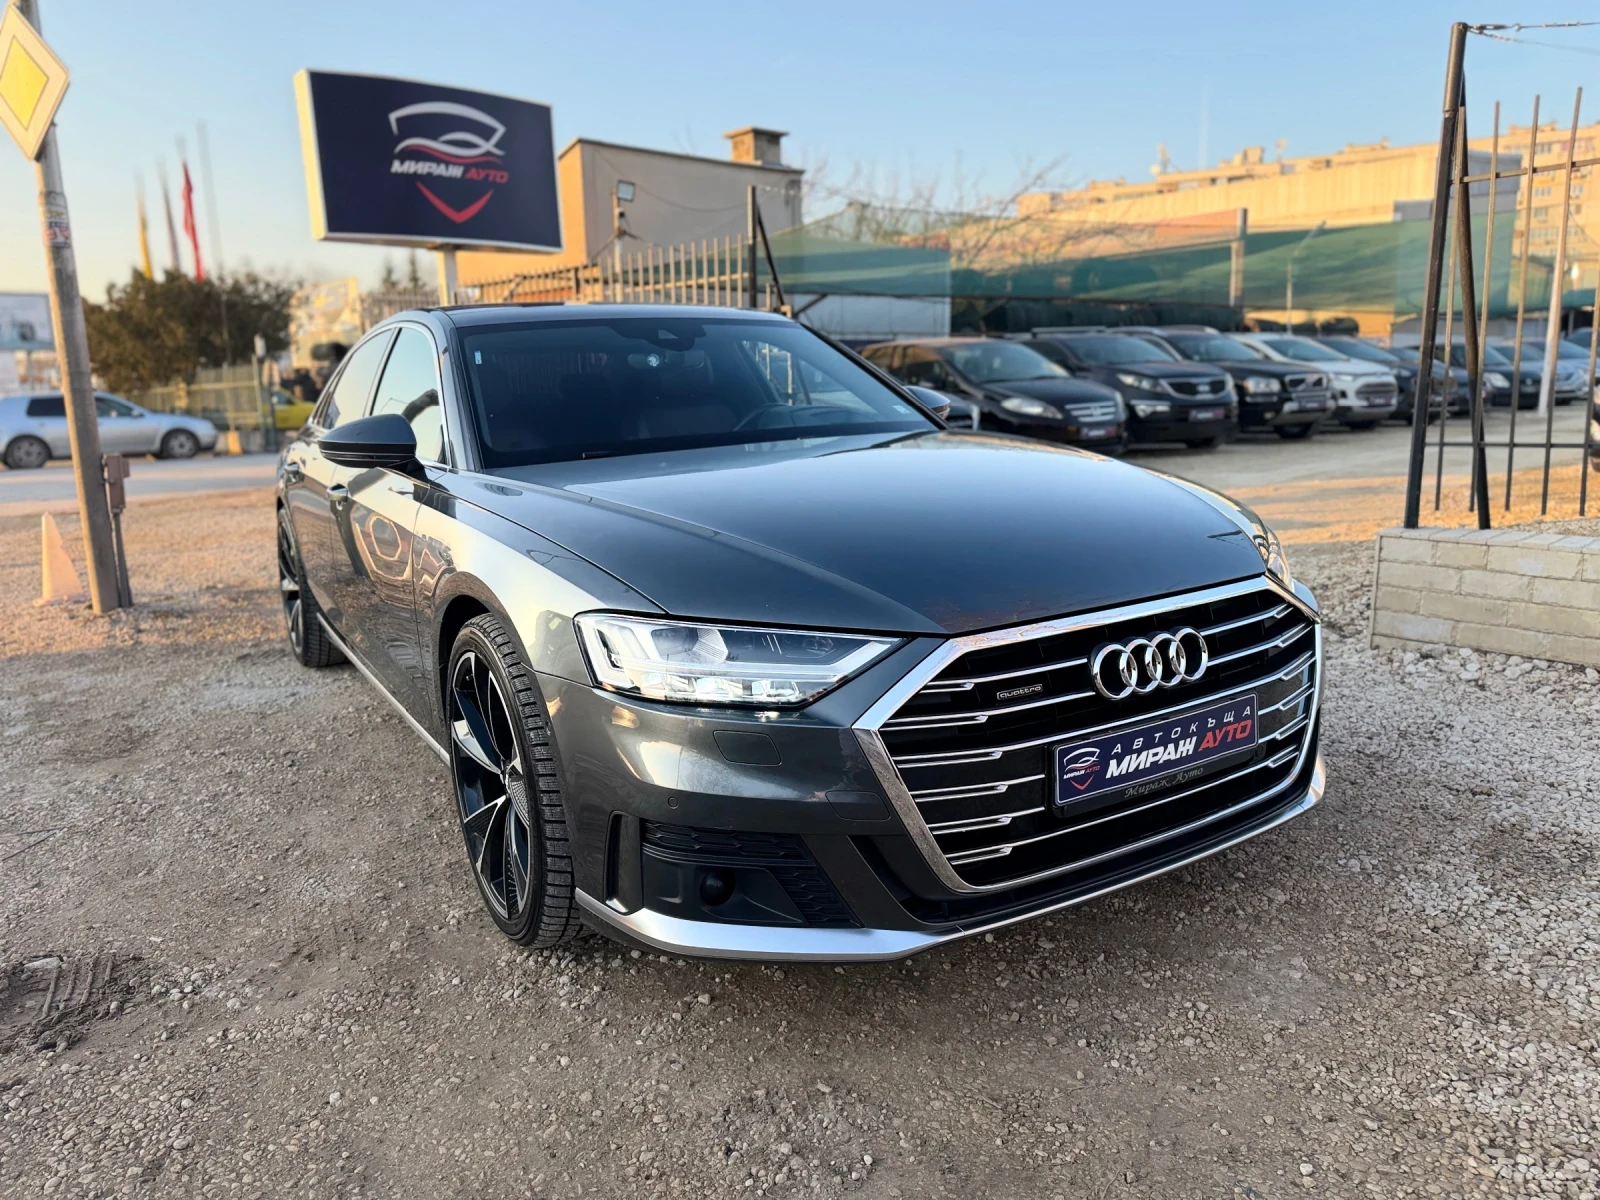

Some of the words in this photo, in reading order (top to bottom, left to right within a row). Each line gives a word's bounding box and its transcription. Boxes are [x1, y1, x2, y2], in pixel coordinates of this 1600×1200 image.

[390, 160, 464, 179] МИРАЖ
[465, 168, 509, 184] АУТО
[1000, 686, 1041, 698] quattro
[1111, 706, 1251, 755] АВТОКЪЩА
[1106, 736, 1197, 779] МИРАЖ
[1198, 720, 1252, 751] АУТО
[1124, 777, 1171, 798] Мираж
[1172, 767, 1204, 785] Ауто
